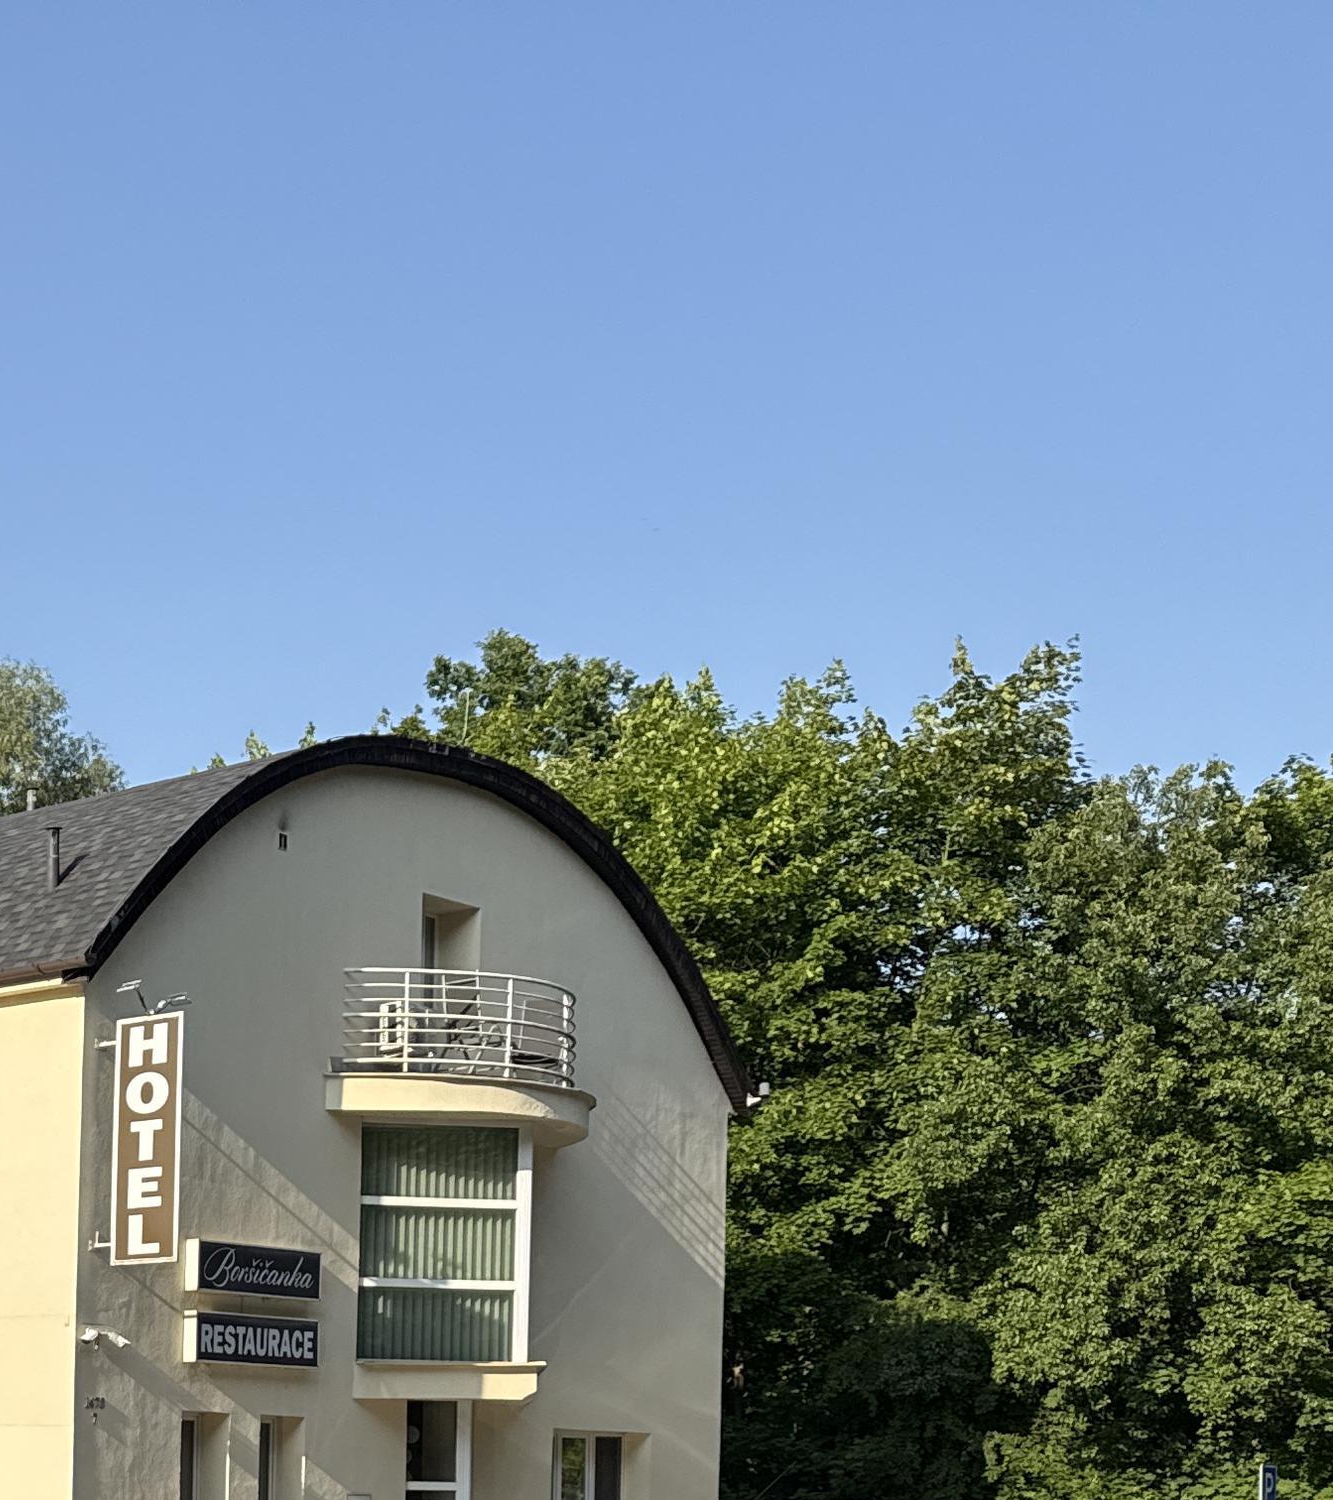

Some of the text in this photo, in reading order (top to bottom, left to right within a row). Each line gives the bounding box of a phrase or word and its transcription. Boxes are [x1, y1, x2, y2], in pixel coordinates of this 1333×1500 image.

[124, 1022, 171, 1257] HOTEL
[203, 1246, 315, 1289] Boršičanka
[200, 1323, 314, 1360] RESTAURACE
